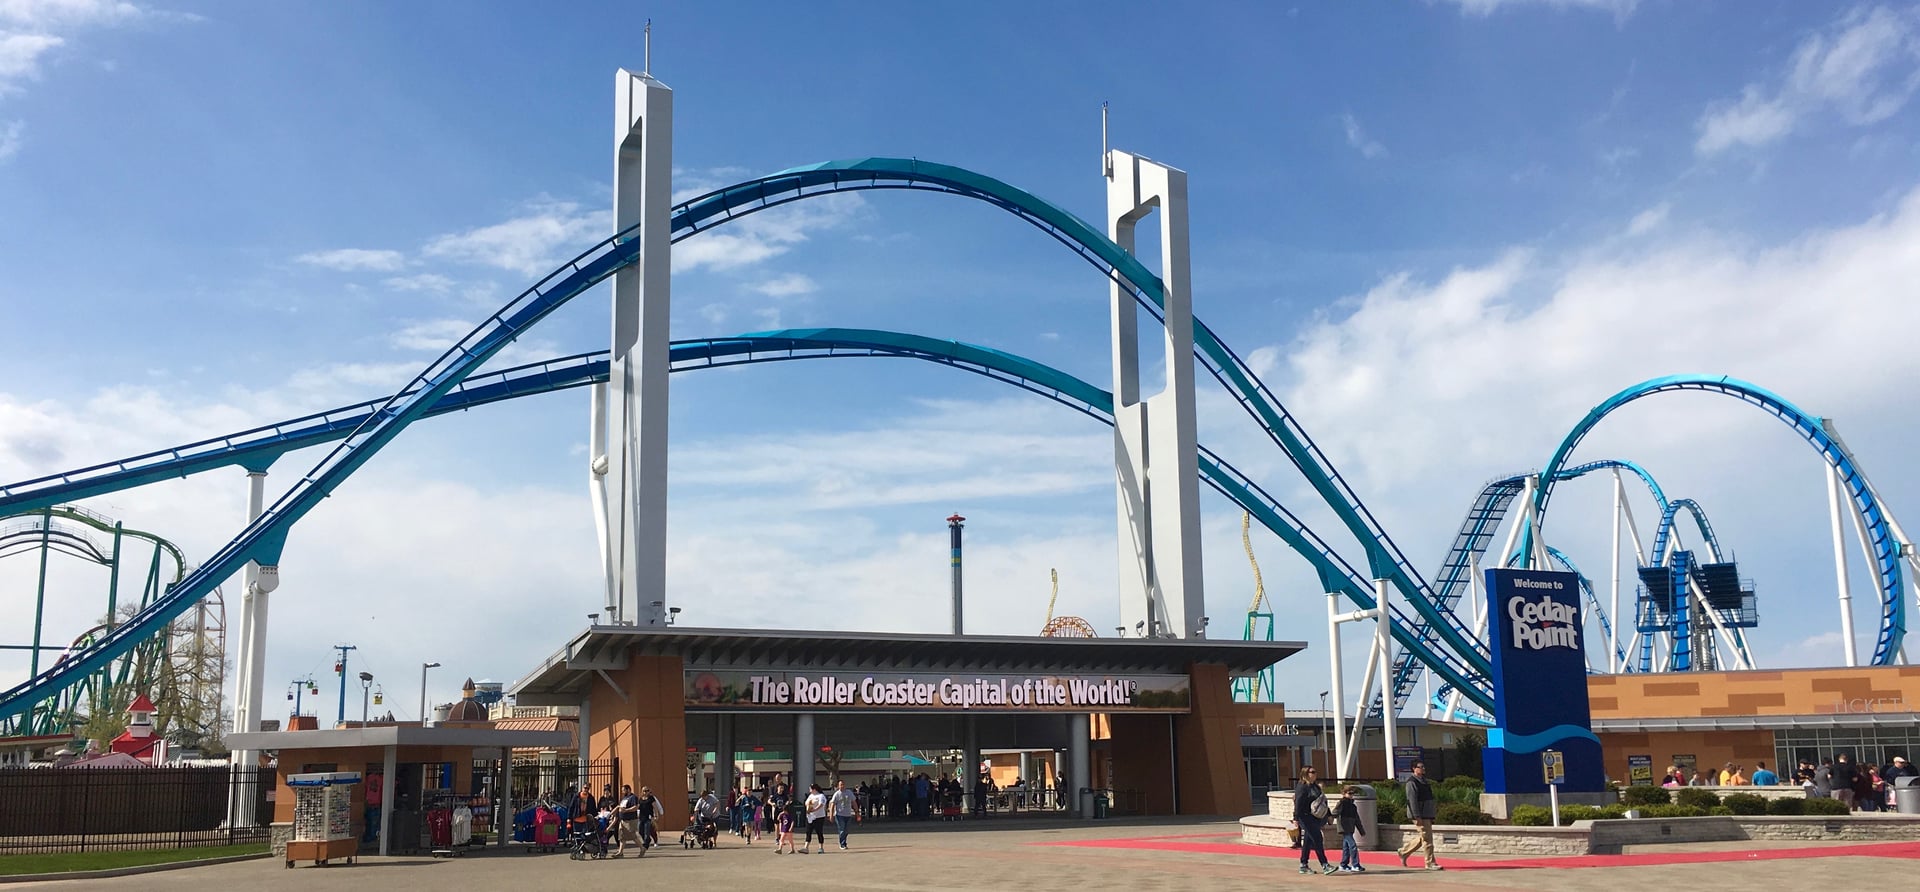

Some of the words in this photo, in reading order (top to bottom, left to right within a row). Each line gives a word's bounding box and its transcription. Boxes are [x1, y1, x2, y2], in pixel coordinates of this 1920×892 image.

[1513, 578, 1553, 589] Welcome
[1553, 581, 1564, 590] to
[1508, 595, 1577, 625] Cedar
[1512, 620, 1578, 650] Point
[750, 675, 790, 704] The
[794, 676, 857, 704] Roller
[860, 677, 936, 705] Coaster
[939, 678, 1007, 709] Capital
[1011, 679, 1032, 705] of
[1034, 679, 1066, 706] the
[1832, 697, 1912, 713] TICKETS
[1250, 724, 1299, 736] SERVICES
